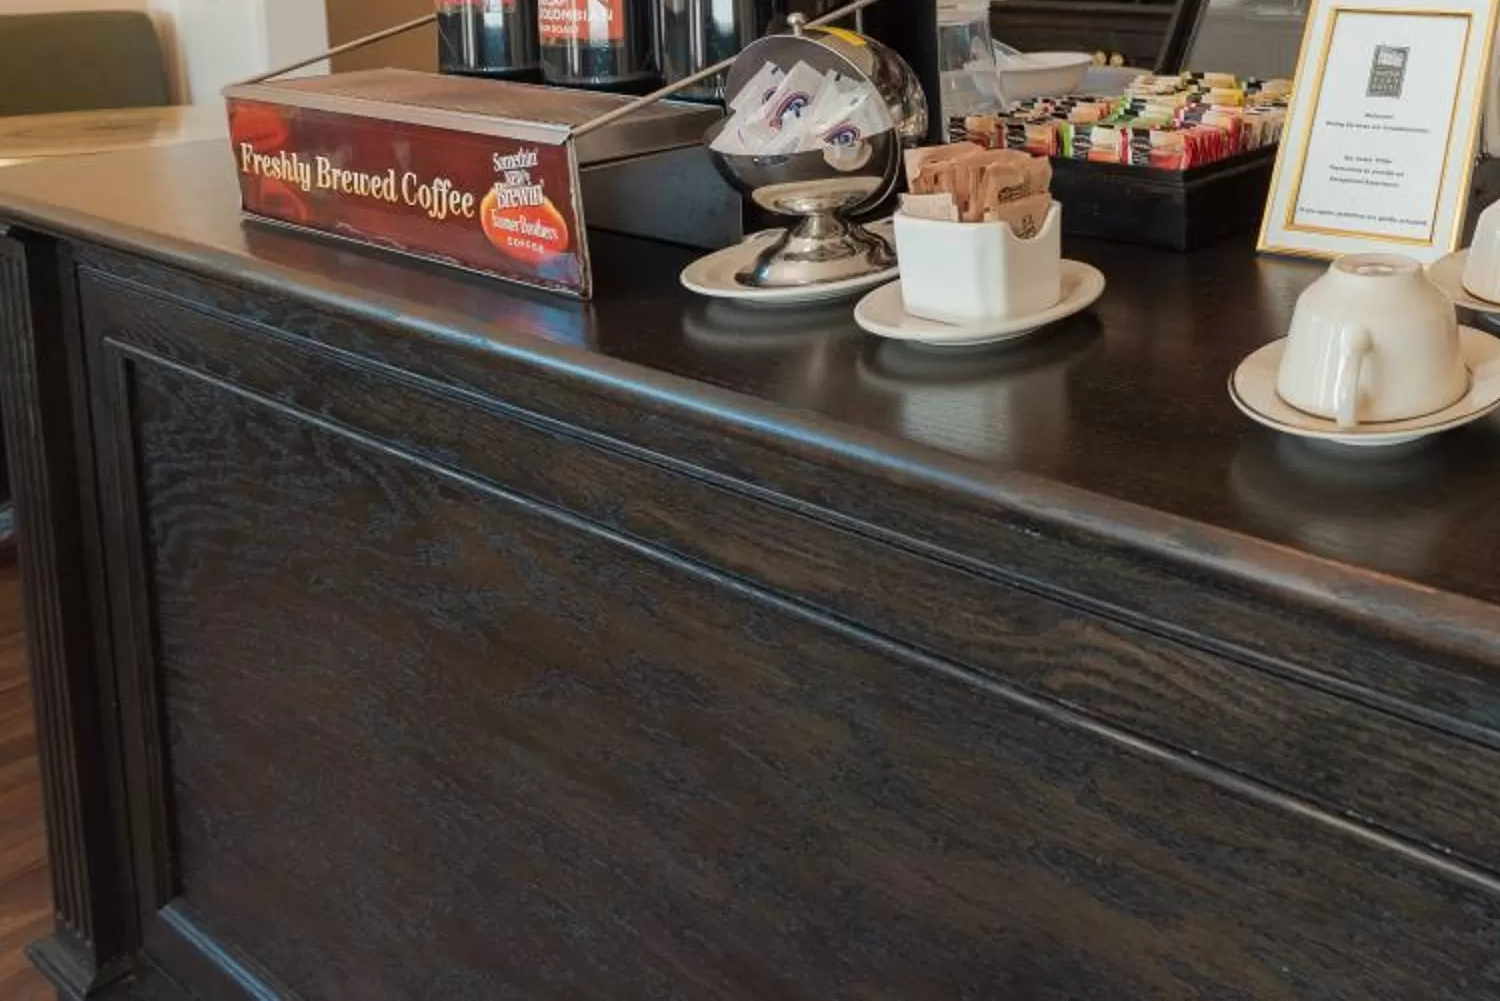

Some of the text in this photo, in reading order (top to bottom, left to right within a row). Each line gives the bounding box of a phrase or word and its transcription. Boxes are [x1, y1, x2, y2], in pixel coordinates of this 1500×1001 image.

[239, 143, 475, 220] Freshly Brewed Coffee
